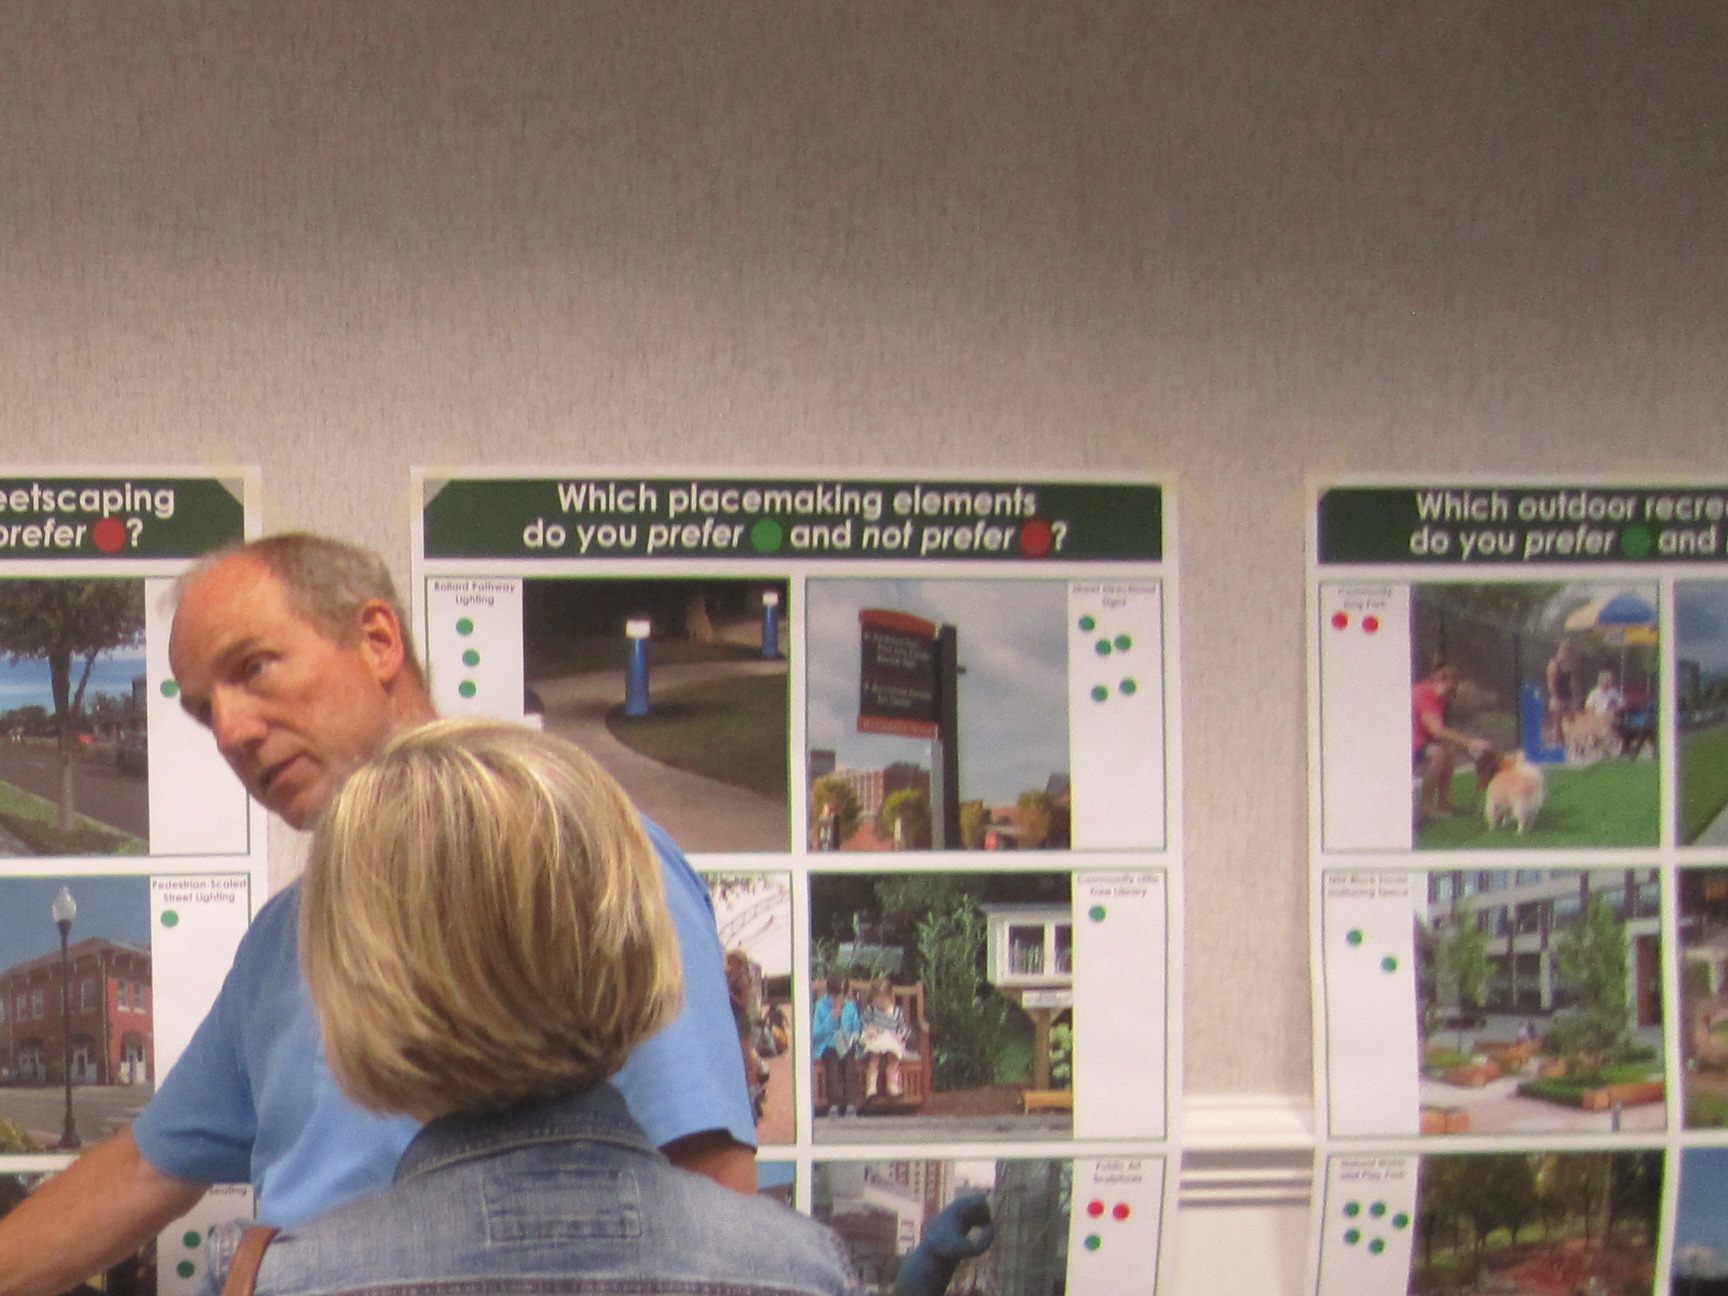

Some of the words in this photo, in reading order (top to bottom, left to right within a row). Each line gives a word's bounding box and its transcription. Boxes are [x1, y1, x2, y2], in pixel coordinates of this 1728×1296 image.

[557, 482, 658, 514] Which
[669, 482, 883, 521] placemaking
[892, 484, 1037, 516] elements
[1416, 491, 1509, 521] Which
[1518, 491, 1636, 521] outdoor
[1645, 496, 1728, 521] recre
[522, 517, 567, 549] do
[576, 524, 638, 555] you
[646, 516, 745, 555] prefer
[790, 518, 852, 550] and
[861, 518, 914, 550] not
[920, 518, 1016, 556] prefer
[1409, 525, 1450, 556] do
[1459, 531, 1516, 561] you
[1523, 525, 1615, 561] prefer
[1658, 524, 1718, 555] and
[455, 594, 494, 605] Lighting
[163, 892, 192, 902] Street
[195, 891, 235, 903] Lighting
